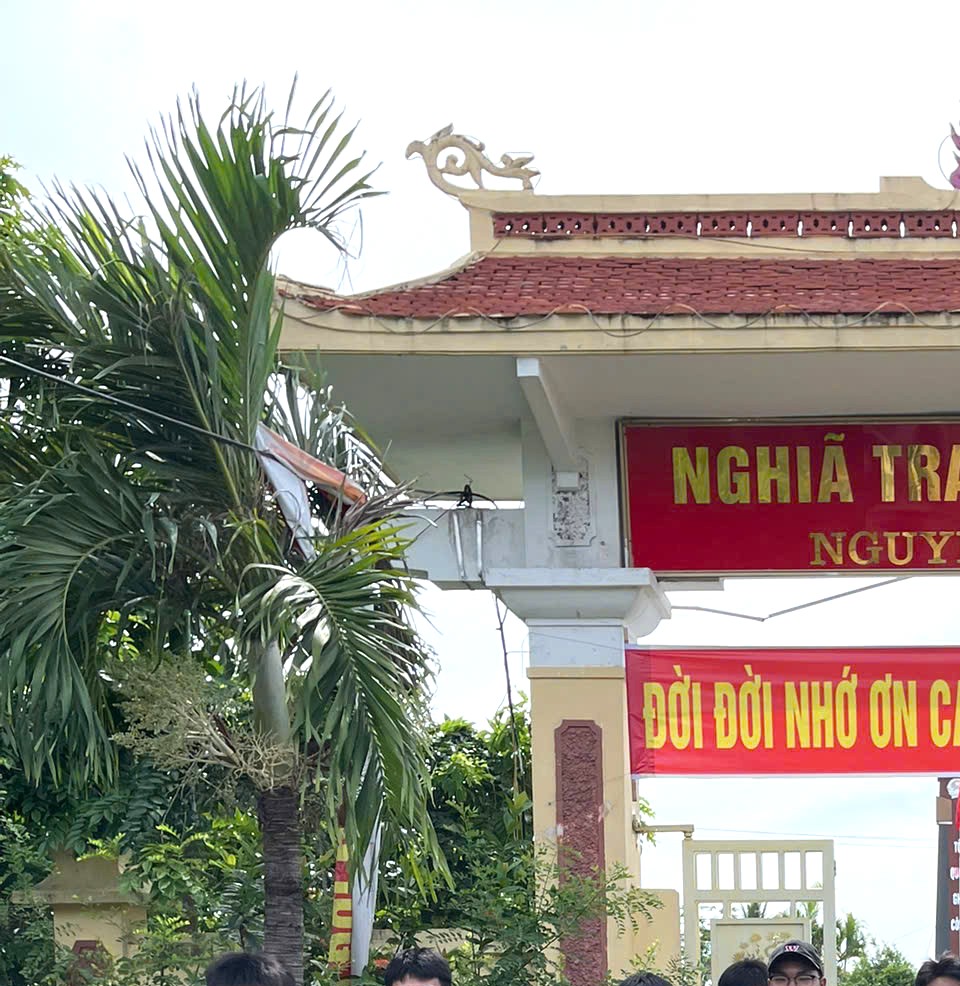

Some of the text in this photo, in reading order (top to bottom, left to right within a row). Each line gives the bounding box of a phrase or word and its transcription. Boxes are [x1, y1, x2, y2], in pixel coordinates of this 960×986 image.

[672, 433, 853, 505] NGHIÃ
[642, 664, 704, 750] ĐỜI
[713, 663, 775, 750] ĐỜI
[784, 665, 858, 749] NHỚ
[869, 672, 918, 748] ƠN
